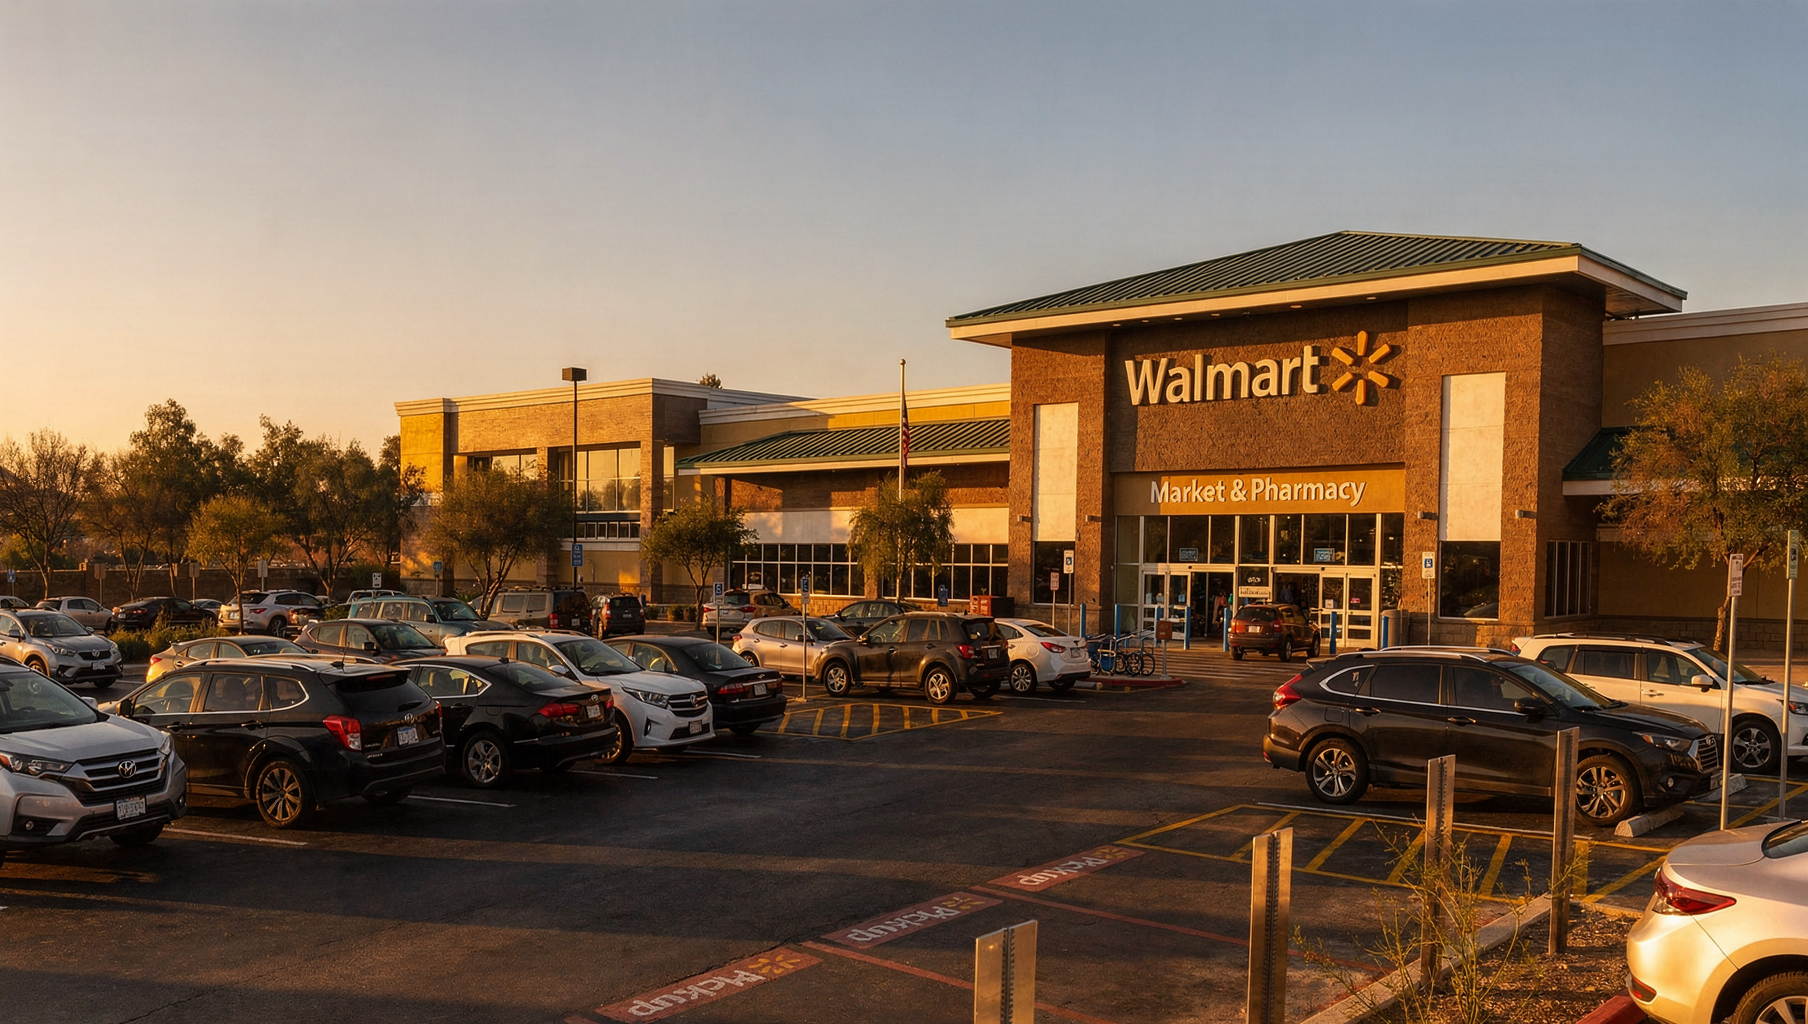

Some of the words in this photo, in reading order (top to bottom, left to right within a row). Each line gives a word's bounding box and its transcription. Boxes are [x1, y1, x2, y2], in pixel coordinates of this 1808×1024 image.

[1124, 345, 1319, 406] Walmart
[1151, 478, 1226, 504] Market
[1230, 478, 1249, 502] &
[1251, 477, 1366, 507] Pharmacy
[1018, 857, 1108, 888] Pickup
[845, 906, 961, 944] Pickup
